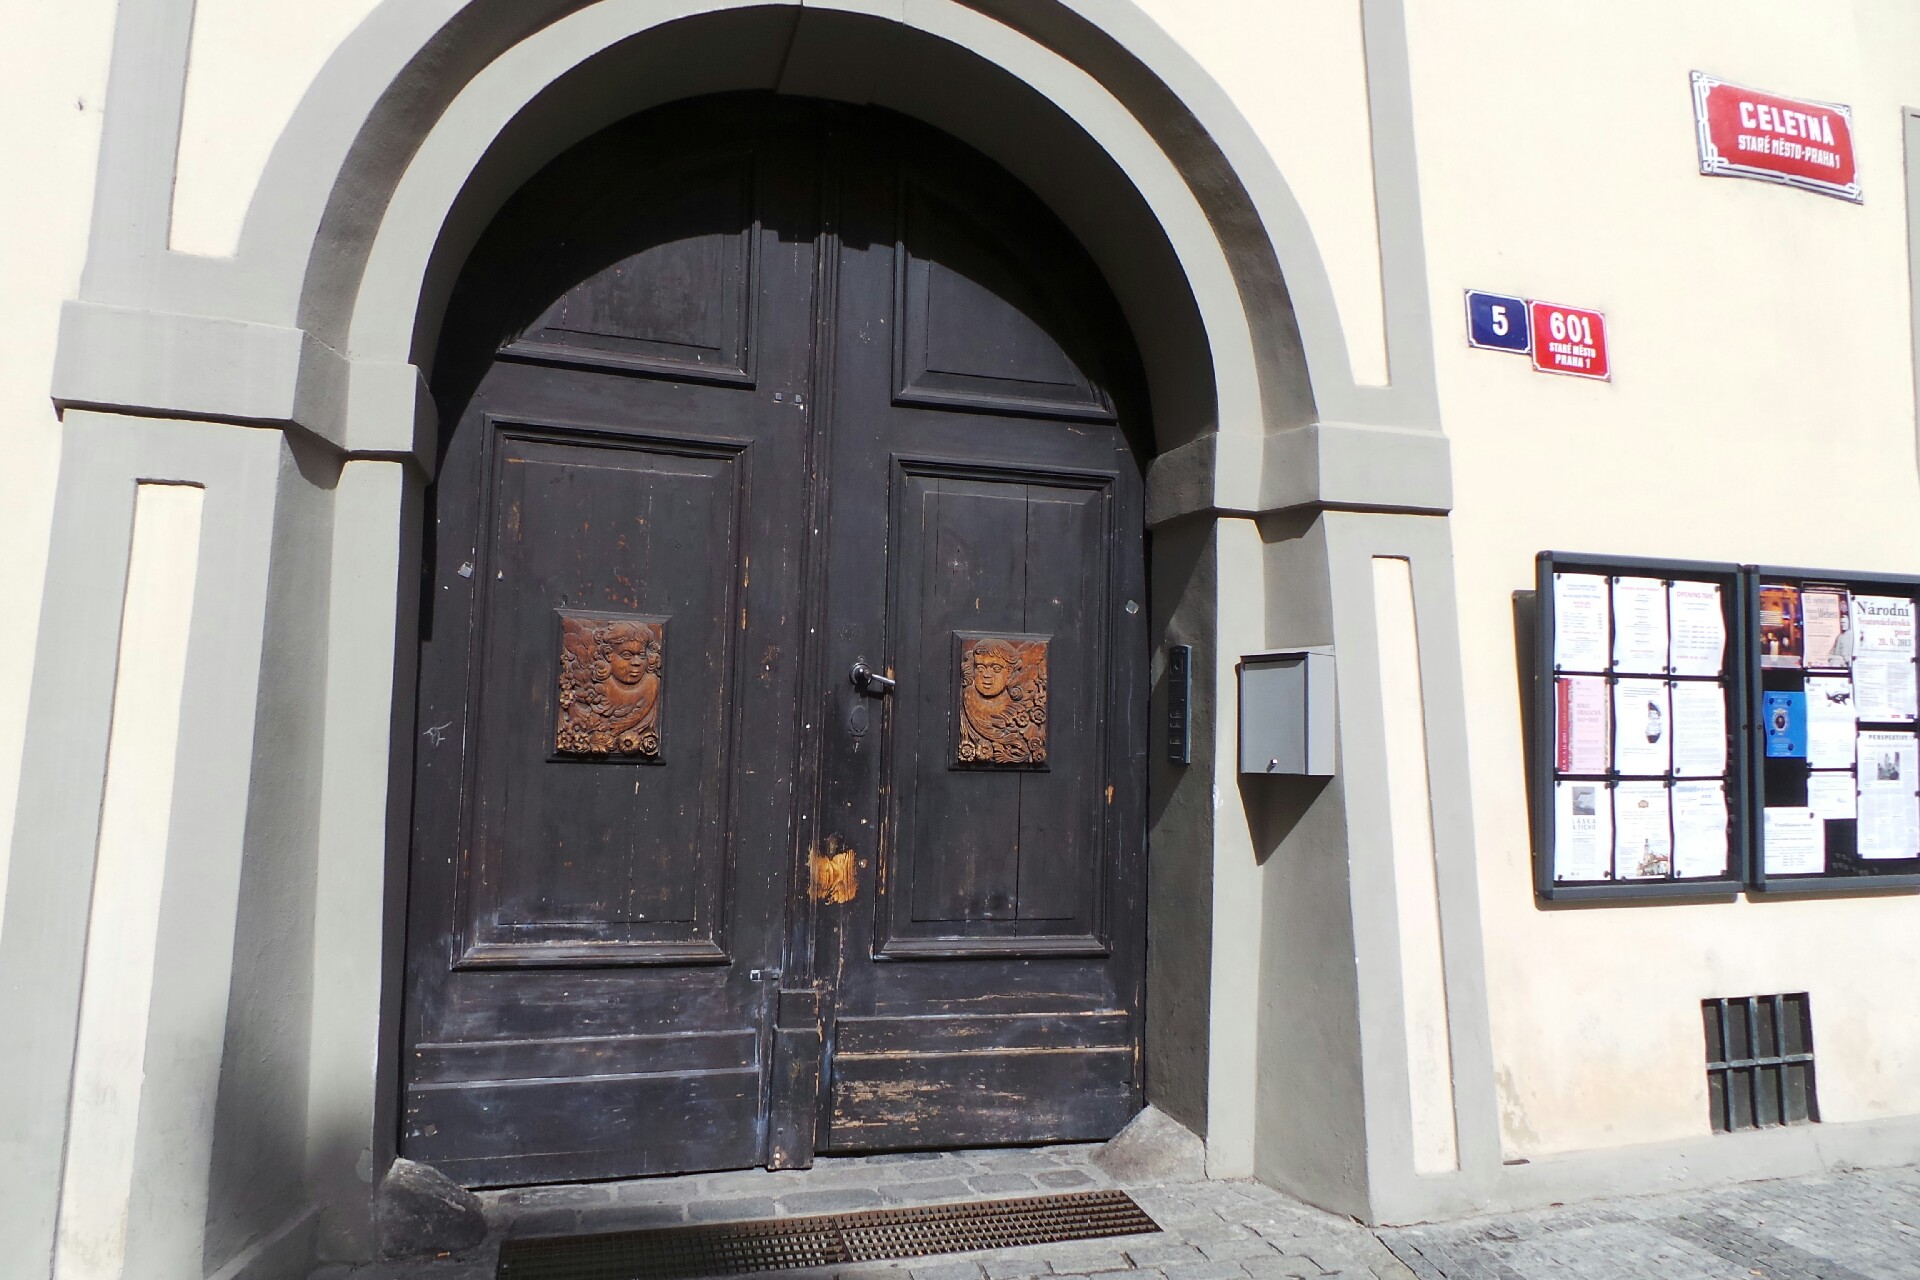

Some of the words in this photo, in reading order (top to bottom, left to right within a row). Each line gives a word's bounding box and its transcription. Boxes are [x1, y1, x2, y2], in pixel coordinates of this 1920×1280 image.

[1739, 101, 1835, 146] CELETNÁ
[1738, 134, 1770, 154] STARÉ
[1835, 154, 1840, 169] 1
[1491, 305, 1509, 336] 5
[1550, 311, 1593, 345] 601
[1549, 342, 1572, 354] STARÉ
[1555, 354, 1584, 368] PRAHA
[1584, 358, 1591, 369] 1
[1856, 600, 1910, 617] Národní
